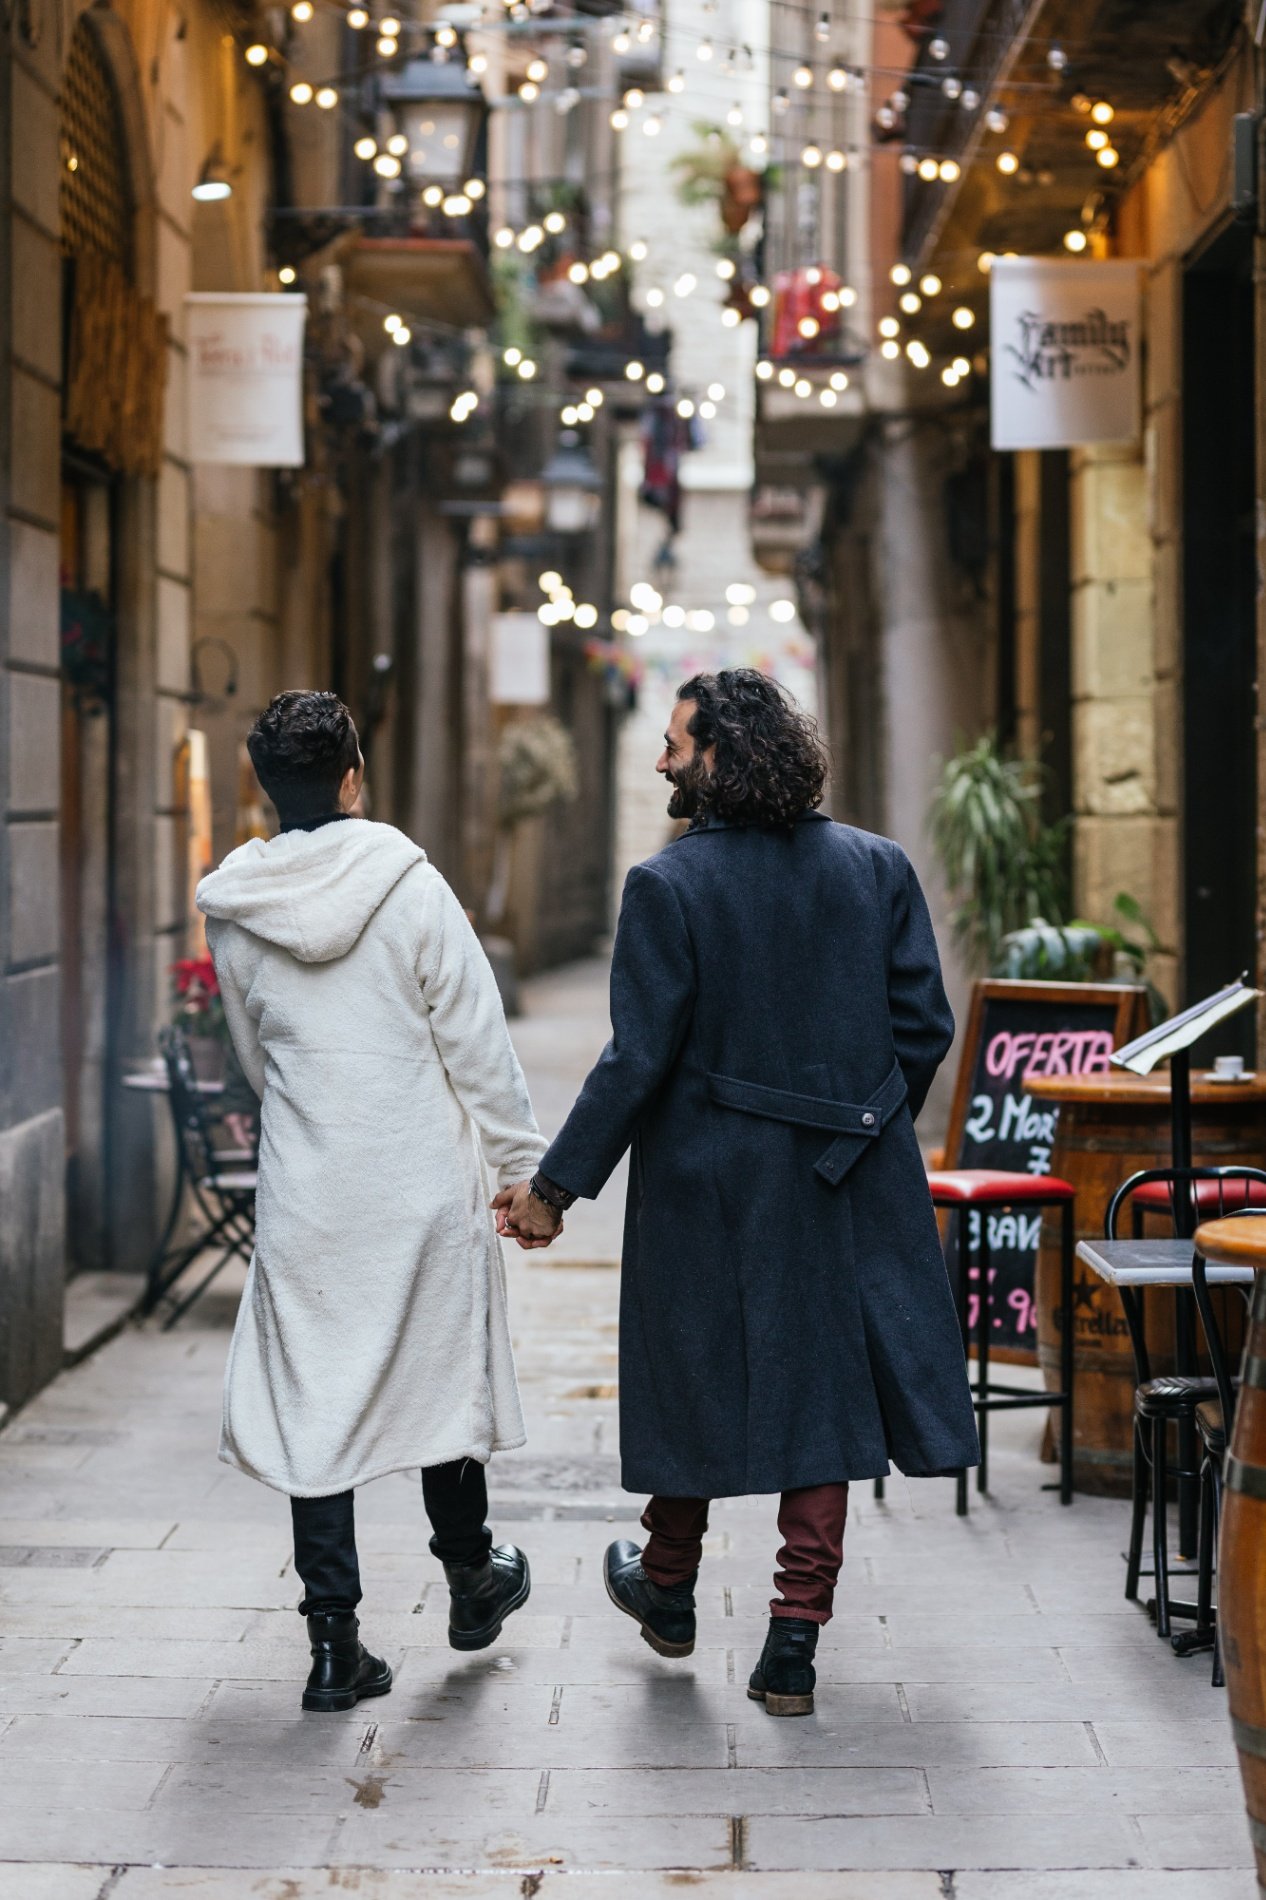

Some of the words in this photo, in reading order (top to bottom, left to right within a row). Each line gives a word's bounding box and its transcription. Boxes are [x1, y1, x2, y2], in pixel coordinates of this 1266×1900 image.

[1016, 307, 1131, 371] Family
[986, 1031, 1114, 1079] OFERTA
[965, 1094, 995, 1143] 2
